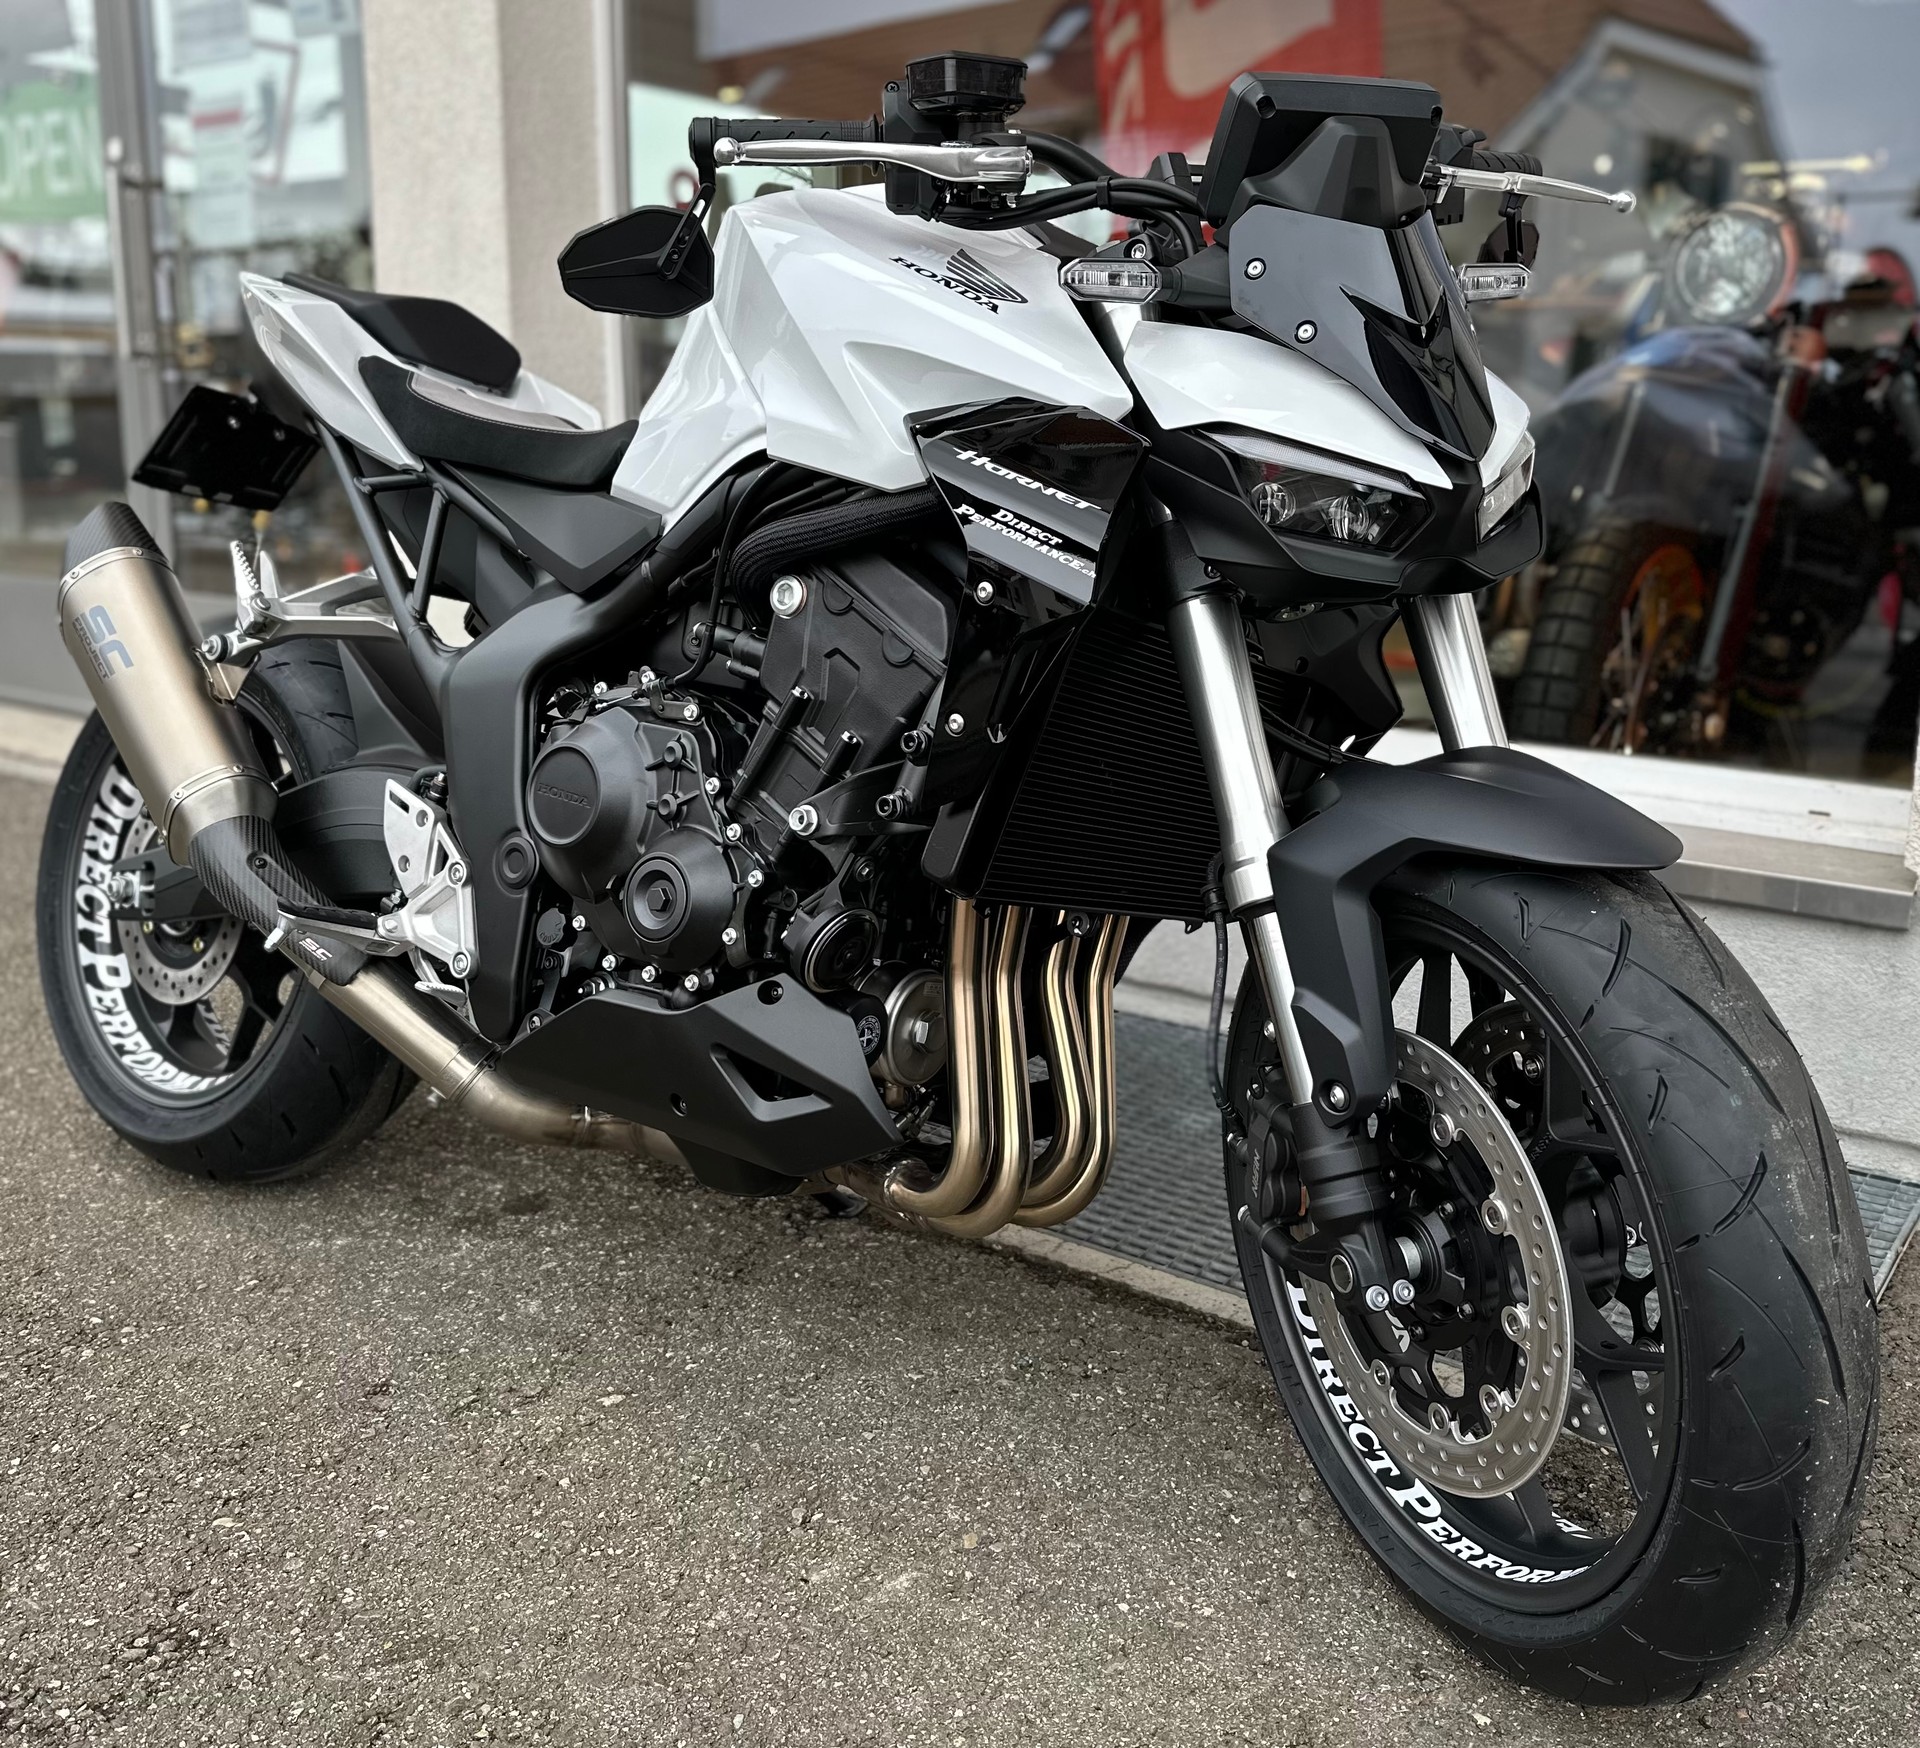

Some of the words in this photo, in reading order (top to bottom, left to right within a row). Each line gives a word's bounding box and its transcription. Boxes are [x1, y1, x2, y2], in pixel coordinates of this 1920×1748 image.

[889, 256, 999, 315] HONDA
[952, 447, 1102, 510] HORNET
[991, 508, 1063, 546] DIRECT
[74, 616, 110, 679] PROJECT
[80, 605, 134, 677] SC
[537, 783, 591, 808] HONDA
[1286, 1281, 1401, 1478] DIRECT
